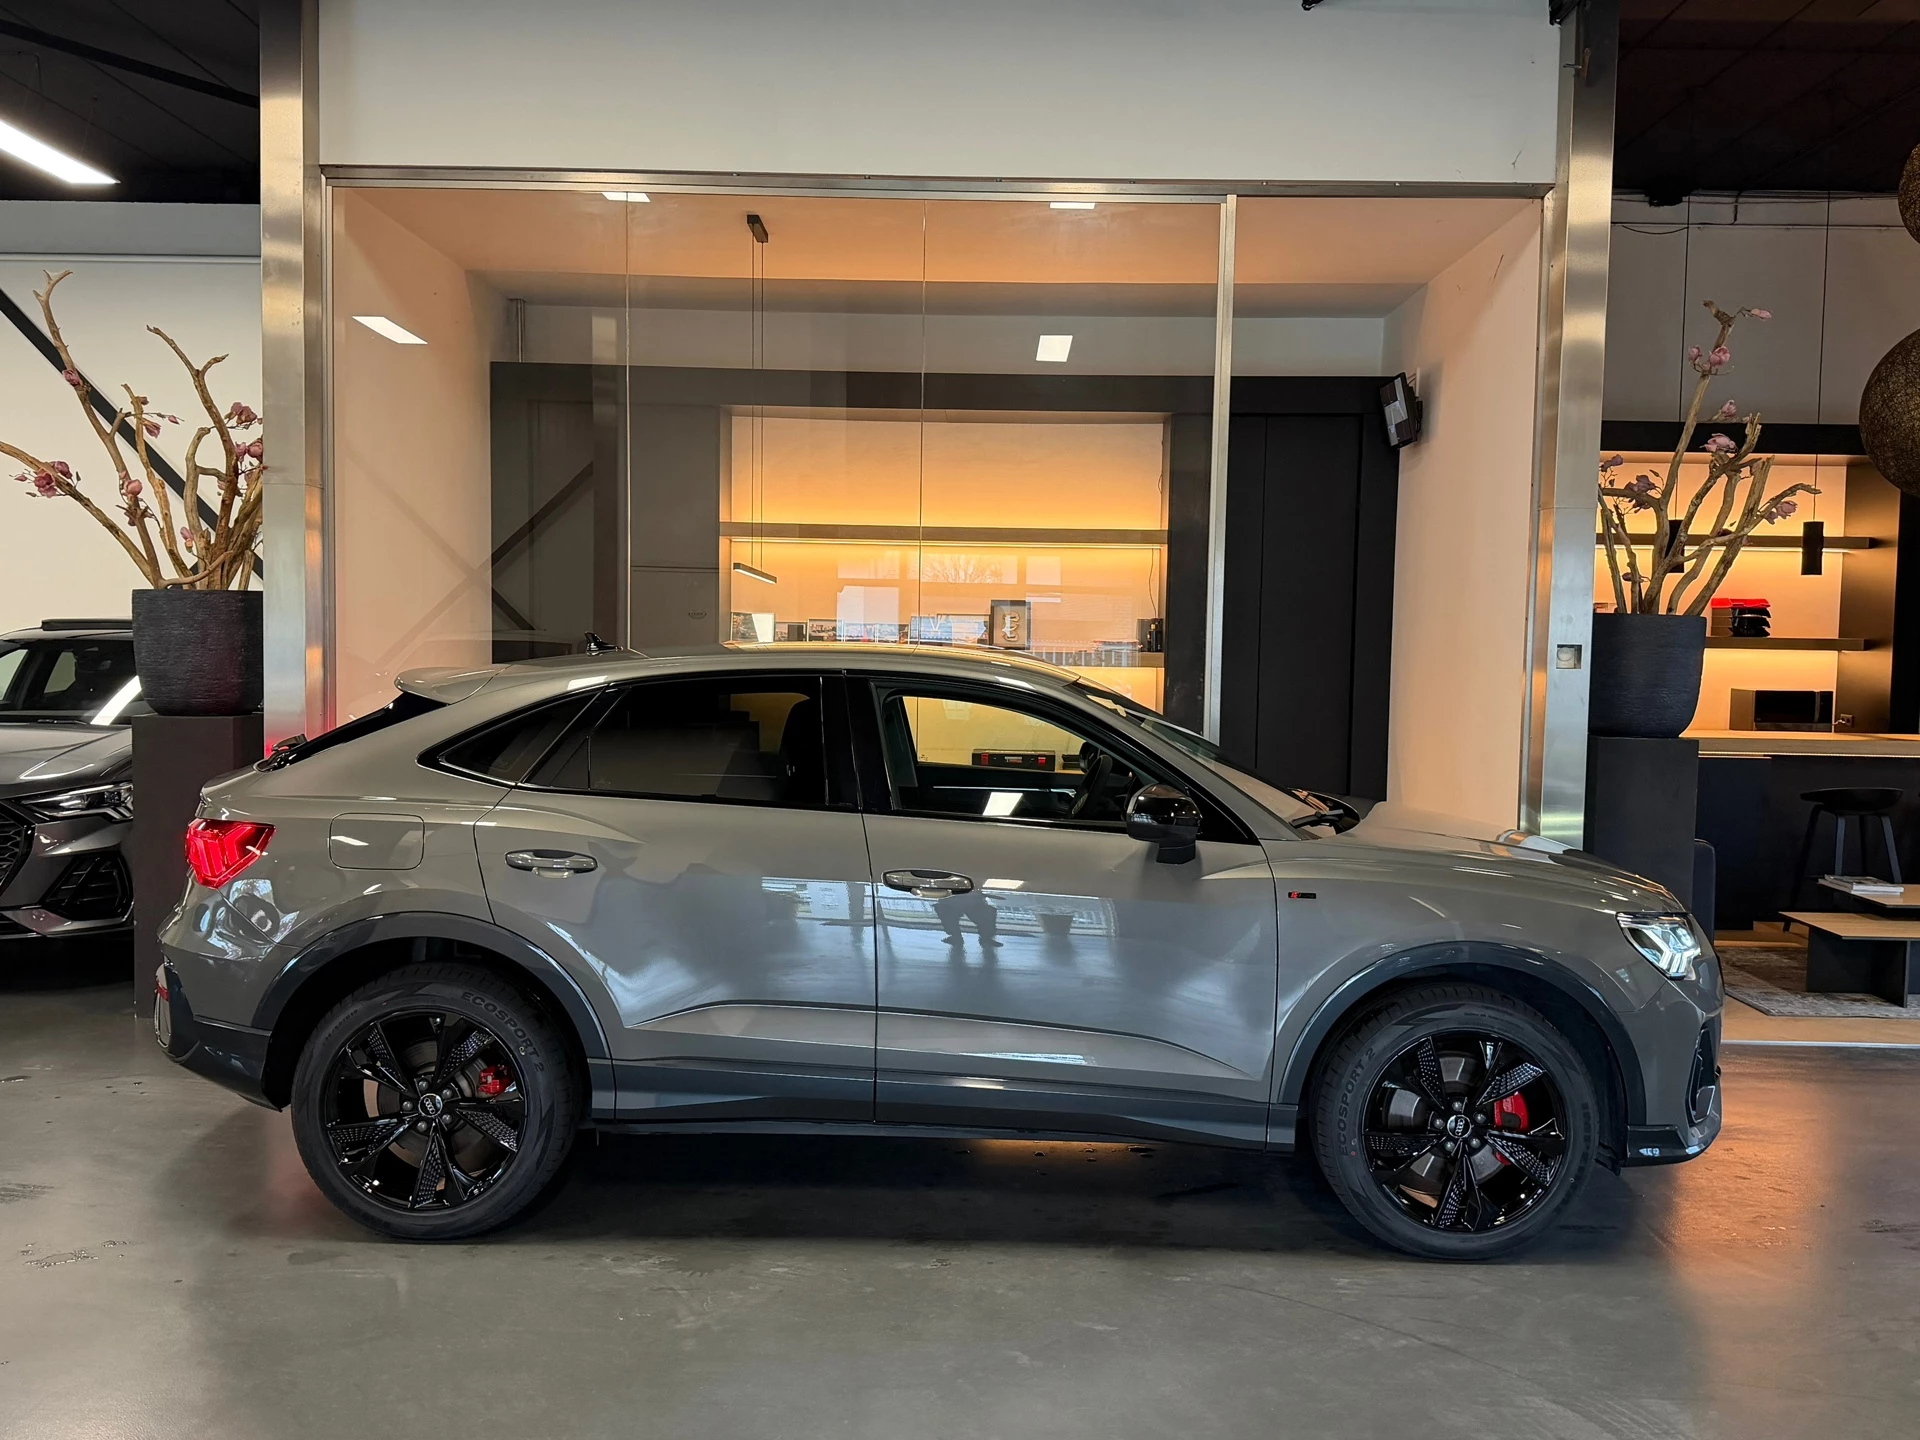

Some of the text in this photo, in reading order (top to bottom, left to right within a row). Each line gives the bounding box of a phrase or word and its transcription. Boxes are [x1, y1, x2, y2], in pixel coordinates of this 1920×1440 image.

[460, 991, 545, 1073] ECOSPORT 2
[1337, 1047, 1376, 1157] ECOSPORT 2
